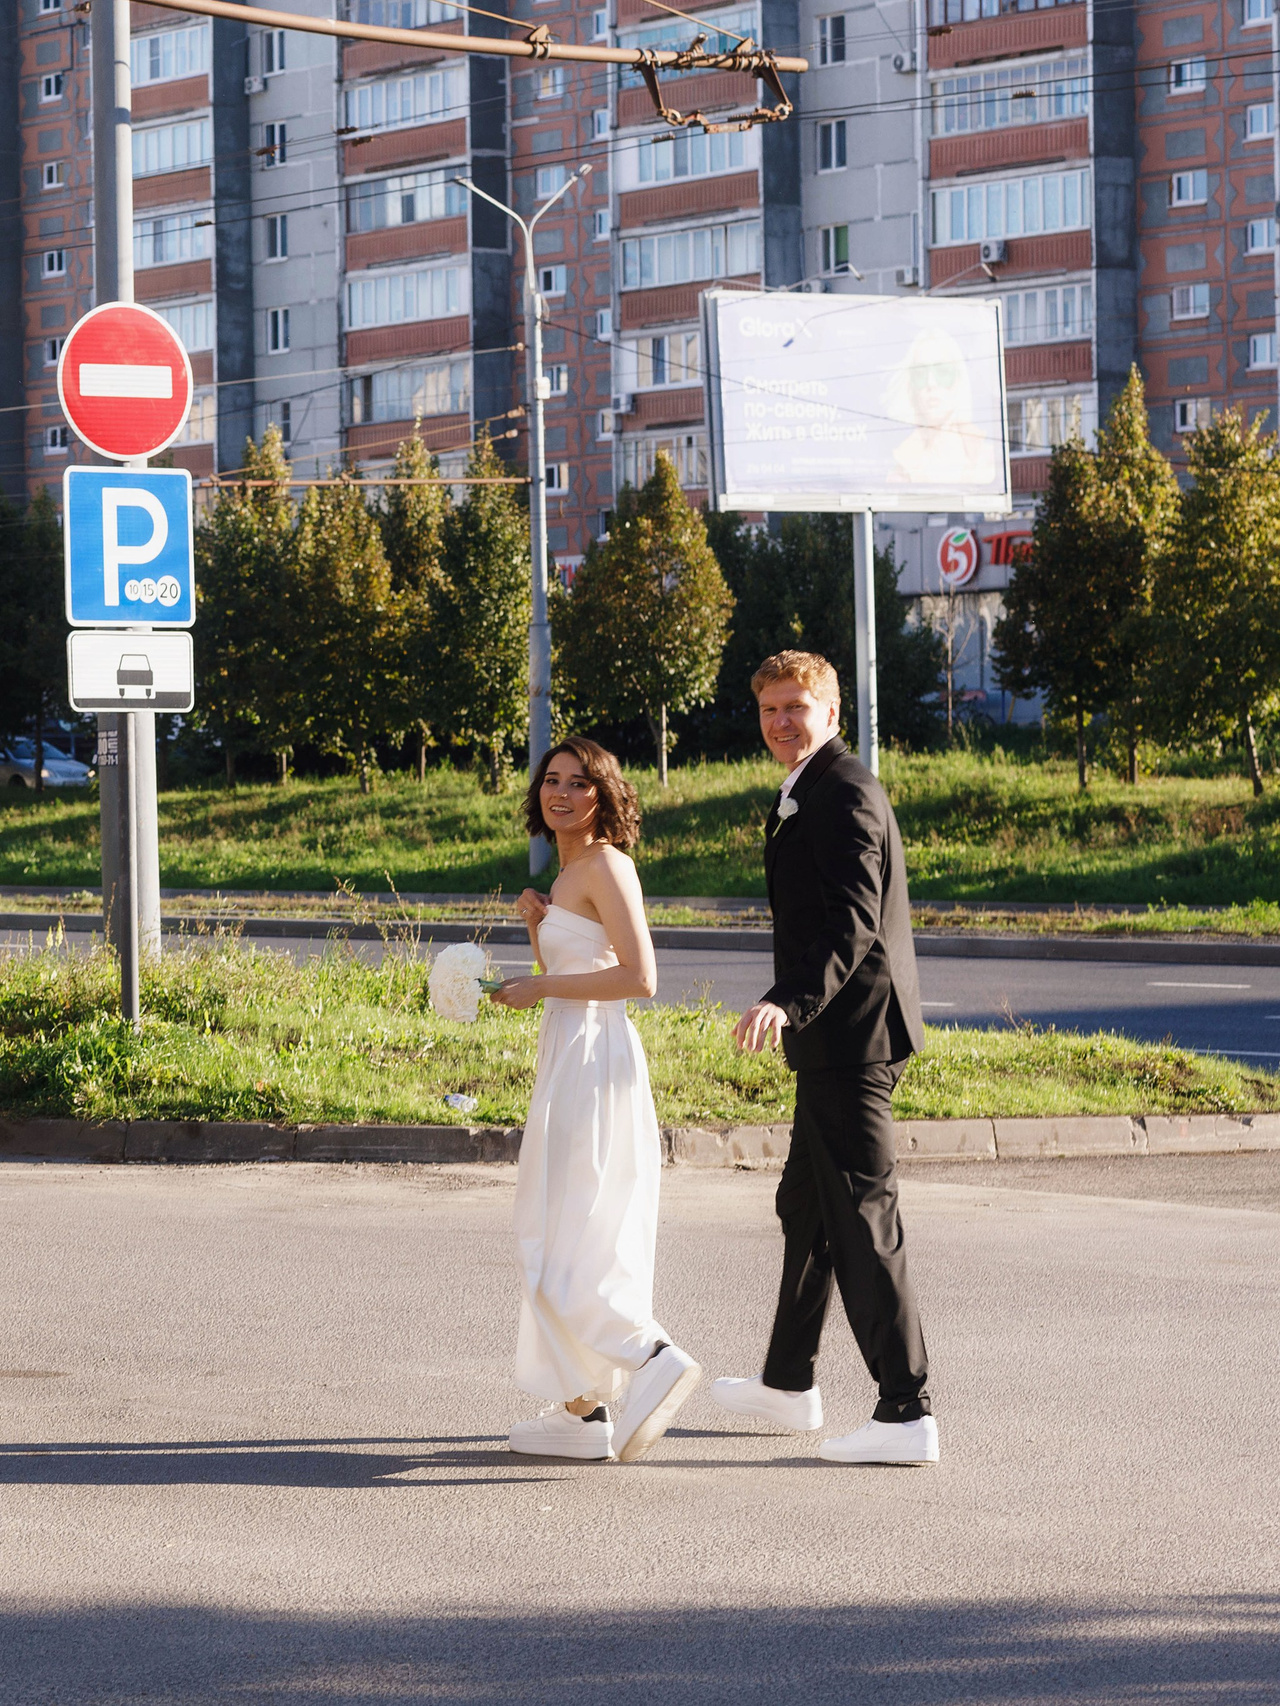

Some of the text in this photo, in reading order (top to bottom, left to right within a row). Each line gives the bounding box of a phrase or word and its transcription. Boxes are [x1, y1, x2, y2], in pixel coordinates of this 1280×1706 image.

[743, 376, 828, 399] Смотреть
[744, 402, 842, 423] по-своему.
[745, 422, 868, 443] Жить в GloraX
[102, 487, 168, 606] P
[129, 583, 179, 599] 10 15 20
